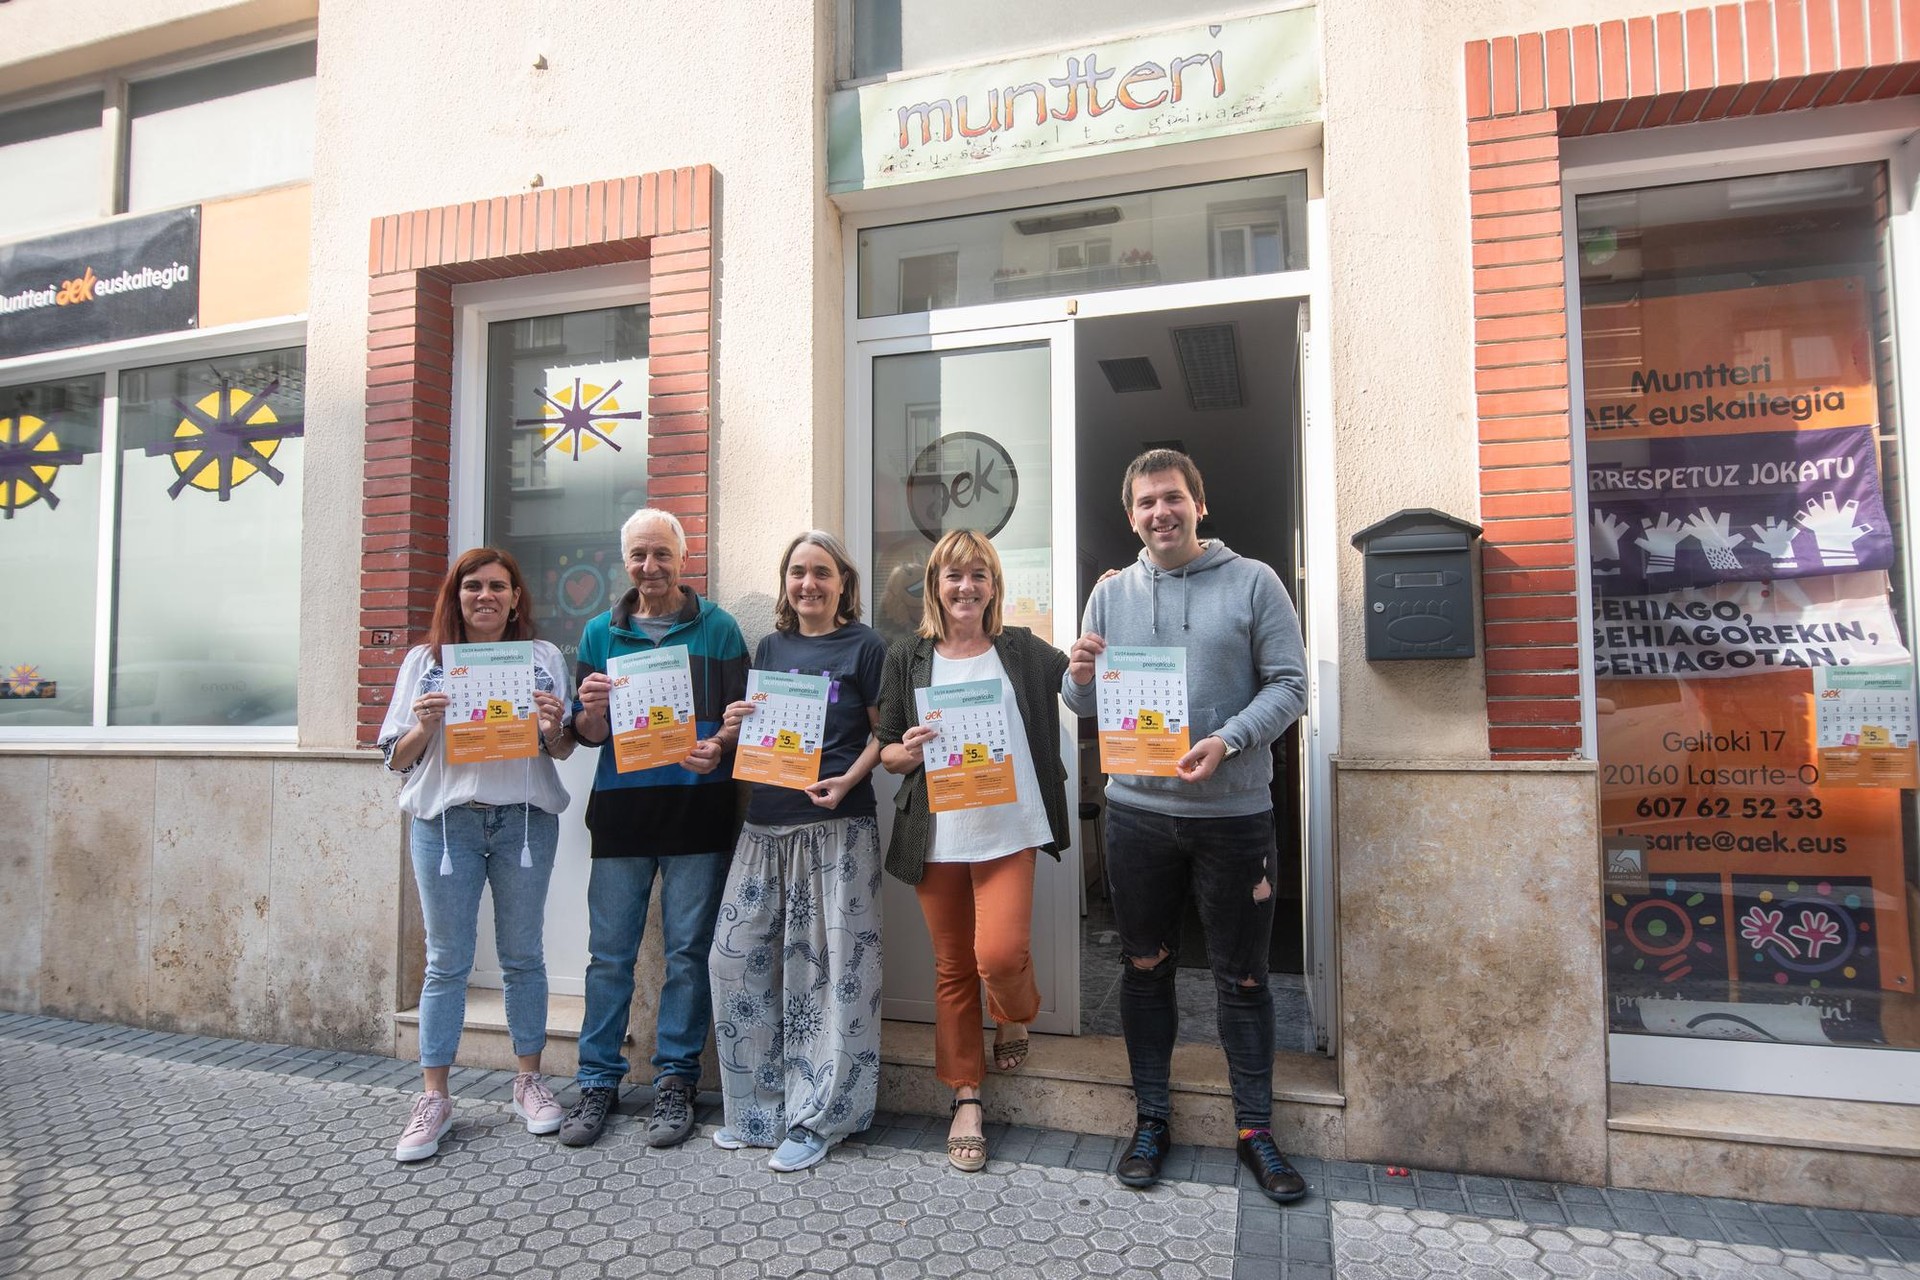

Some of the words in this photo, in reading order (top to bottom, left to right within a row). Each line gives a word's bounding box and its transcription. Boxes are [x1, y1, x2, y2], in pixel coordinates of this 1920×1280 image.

[899, 25, 1227, 148] muntteri
[56, 266, 97, 306] aek
[94, 261, 189, 296] euskaltegia
[1630, 356, 1771, 394] Muntteri
[1648, 386, 1845, 426] euskaltegia
[1748, 456, 1856, 486] JOKATU
[450, 665, 470, 676] aek
[613, 675, 630, 687] aek
[1102, 669, 1121, 681] aek
[751, 692, 769, 702] aek
[1821, 688, 1841, 699] aek
[925, 708, 943, 721] aek
[1662, 729, 1751, 752] Geltoki
[1760, 730, 1786, 752] 17
[1603, 764, 1679, 785] 20160
[1636, 797, 1687, 818] 607
[1697, 797, 1732, 819] 62
[1742, 797, 1777, 819] 52
[1787, 797, 1823, 819] 33
[1617, 829, 1847, 854] sarte@aek.eus
